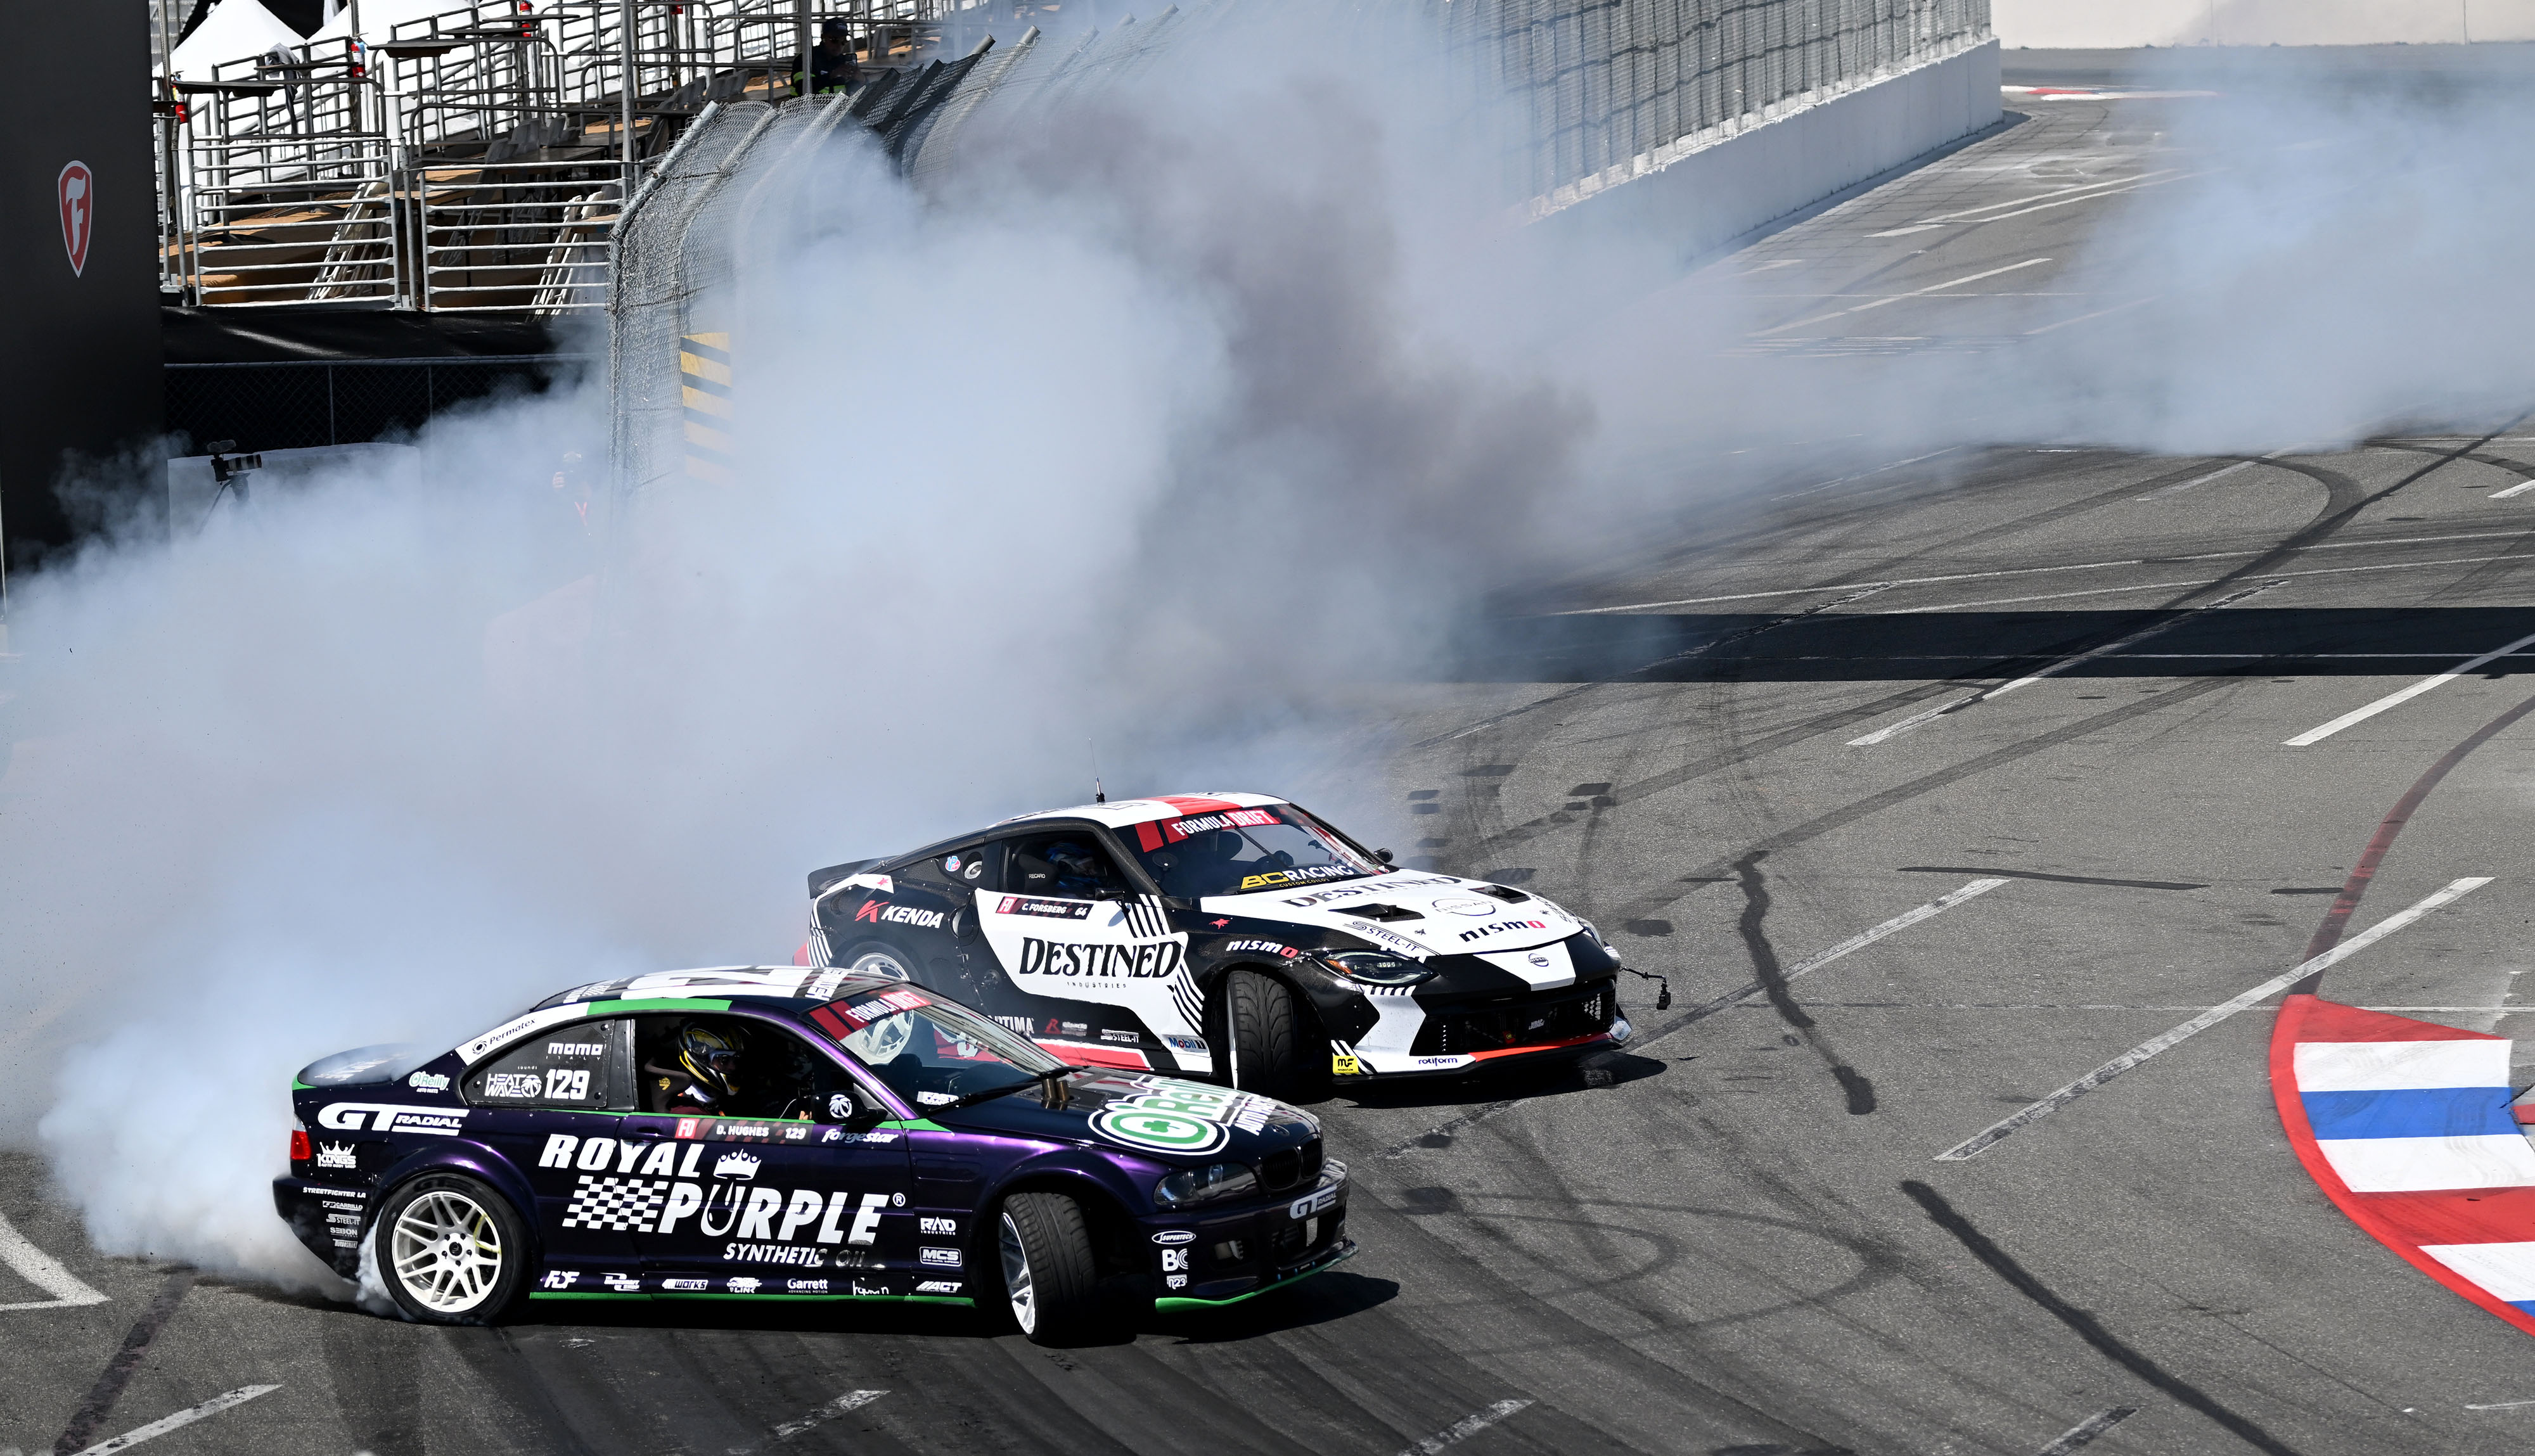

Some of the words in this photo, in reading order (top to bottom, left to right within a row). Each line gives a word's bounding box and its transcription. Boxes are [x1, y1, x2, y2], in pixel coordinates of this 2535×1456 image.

[1171, 815, 1235, 836] FORMULA
[1228, 810, 1274, 827] DRIFT
[999, 898, 1015, 912] FD
[1029, 904, 1067, 914] FORSBERG
[1075, 907, 1088, 916] 64
[881, 905, 944, 929] KENDA
[1366, 928, 1420, 951] STEEL-IT
[1019, 936, 1181, 978] DESTINED
[845, 999, 900, 1023] FORMULA
[883, 990, 927, 1009] DRIFT
[490, 1018, 536, 1045] Permatex
[1112, 1033, 1139, 1043] STEEL-IT
[1169, 1037, 1197, 1049] Mobil
[1418, 1057, 1458, 1066] rotiform
[409, 1071, 450, 1090] O'Reilly
[487, 1073, 527, 1086] HEAT
[544, 1069, 590, 1100] 129
[485, 1085, 524, 1097] WAVE
[318, 1102, 470, 1132] GT
[395, 1115, 462, 1128] RADIAL
[678, 1118, 696, 1137] FD
[716, 1125, 726, 1135] D.
[728, 1125, 769, 1137] HUGHES
[785, 1127, 806, 1140] 129
[821, 1128, 899, 1143] forgestar
[316, 1153, 356, 1166] KINGS
[538, 1134, 705, 1178] ROYAL
[303, 1187, 355, 1197] STREETFIGHTER
[1290, 1184, 1338, 1219] GT
[1318, 1192, 1337, 1204] RADIAL
[658, 1181, 890, 1245] PURPLE
[330, 1227, 358, 1236] SEBON
[920, 1217, 956, 1231] RAD
[723, 1243, 828, 1266] SYNTHETIC
[923, 1249, 959, 1260] MCS
[787, 1279, 828, 1290] Garrett
